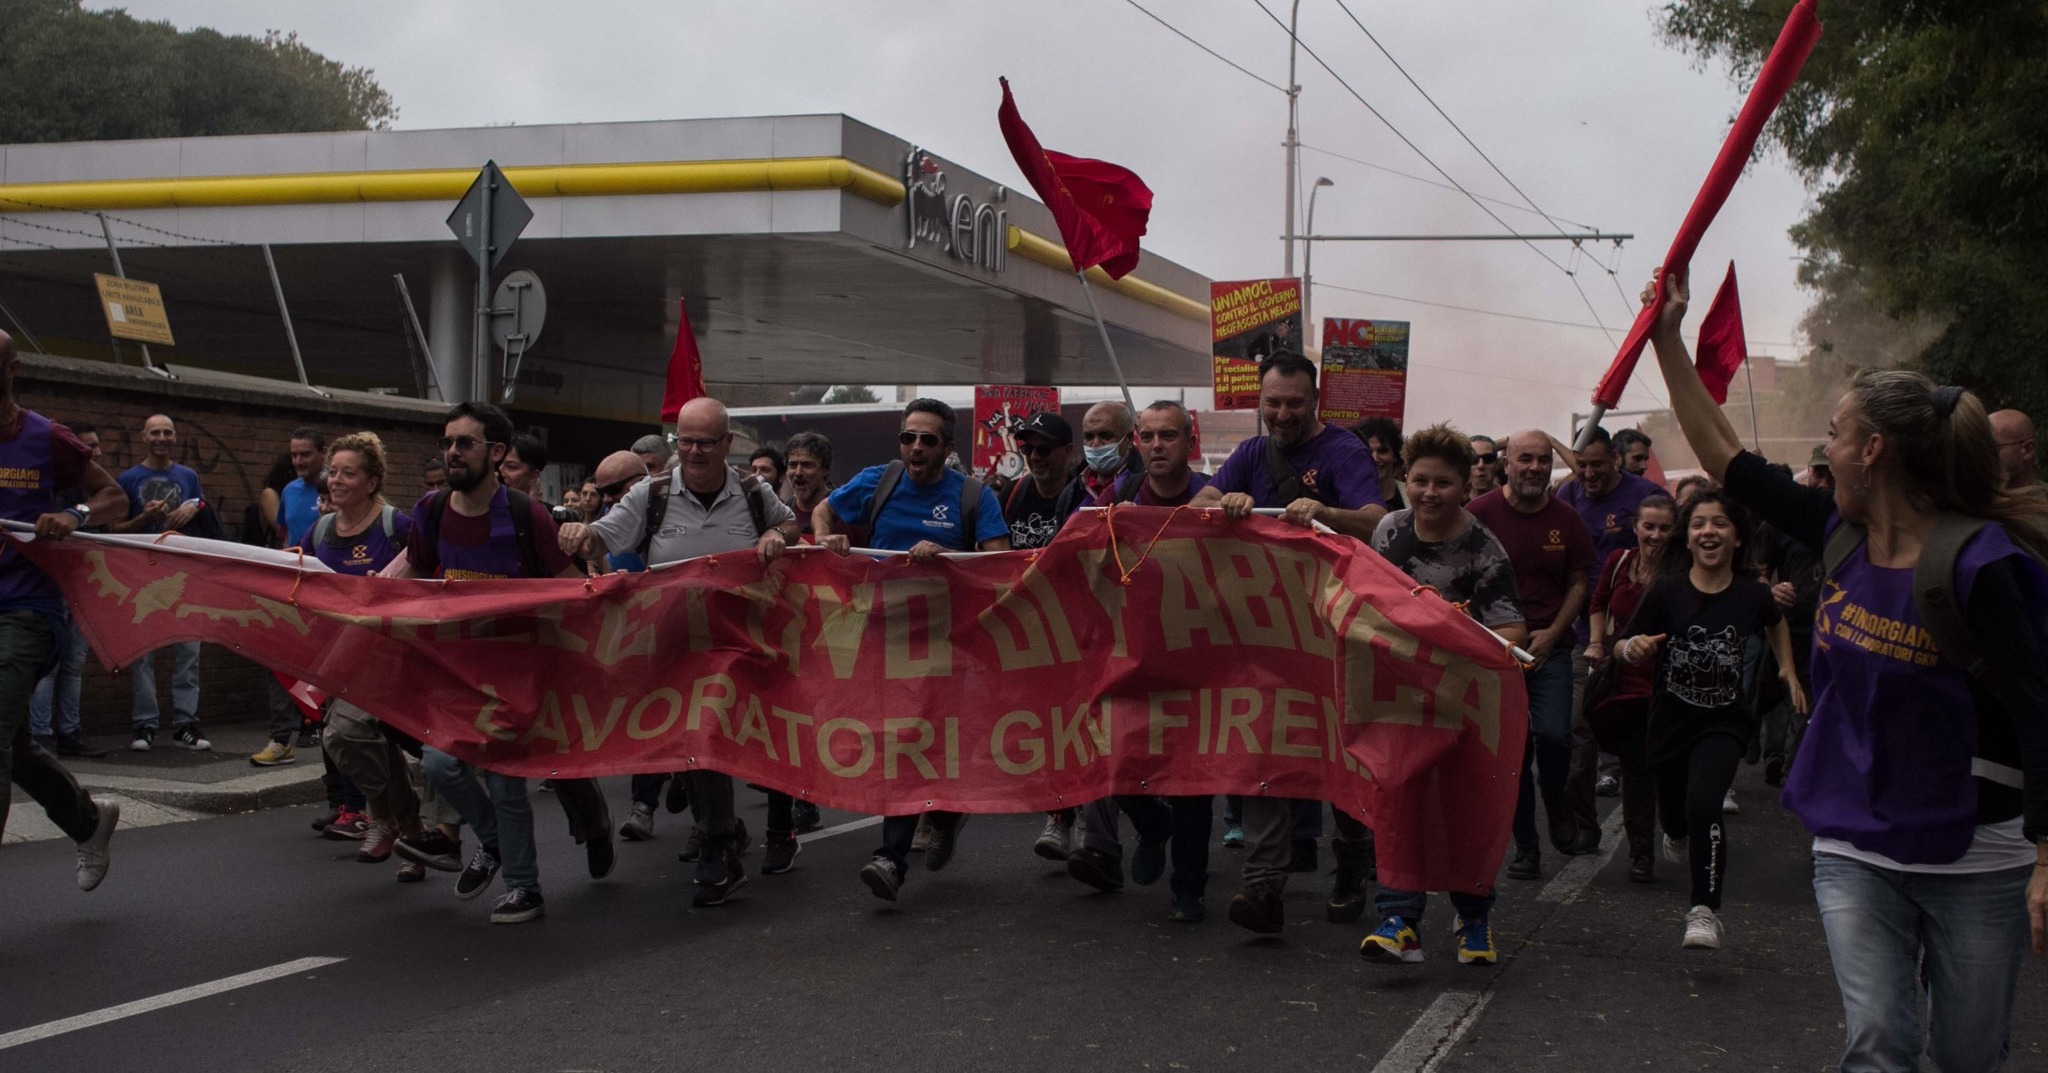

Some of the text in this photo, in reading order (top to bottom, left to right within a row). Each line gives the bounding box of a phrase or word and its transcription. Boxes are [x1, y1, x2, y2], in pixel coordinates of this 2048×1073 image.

[950, 186, 1007, 272] eni
[1212, 280, 1272, 313] UNIAMOCI
[1216, 287, 1297, 324] CONTRO IL GOVERNO
[1216, 300, 1300, 338] NEOFASCISTA MELONI
[1324, 319, 1374, 348] NO
[1215, 356, 1230, 365] Per
[1323, 363, 1344, 373] PER
[1216, 384, 1229, 392] del
[1231, 374, 1259, 384] potere
[1321, 410, 1360, 419] CONTRO
[474, 673, 959, 779] LAVORATORI
